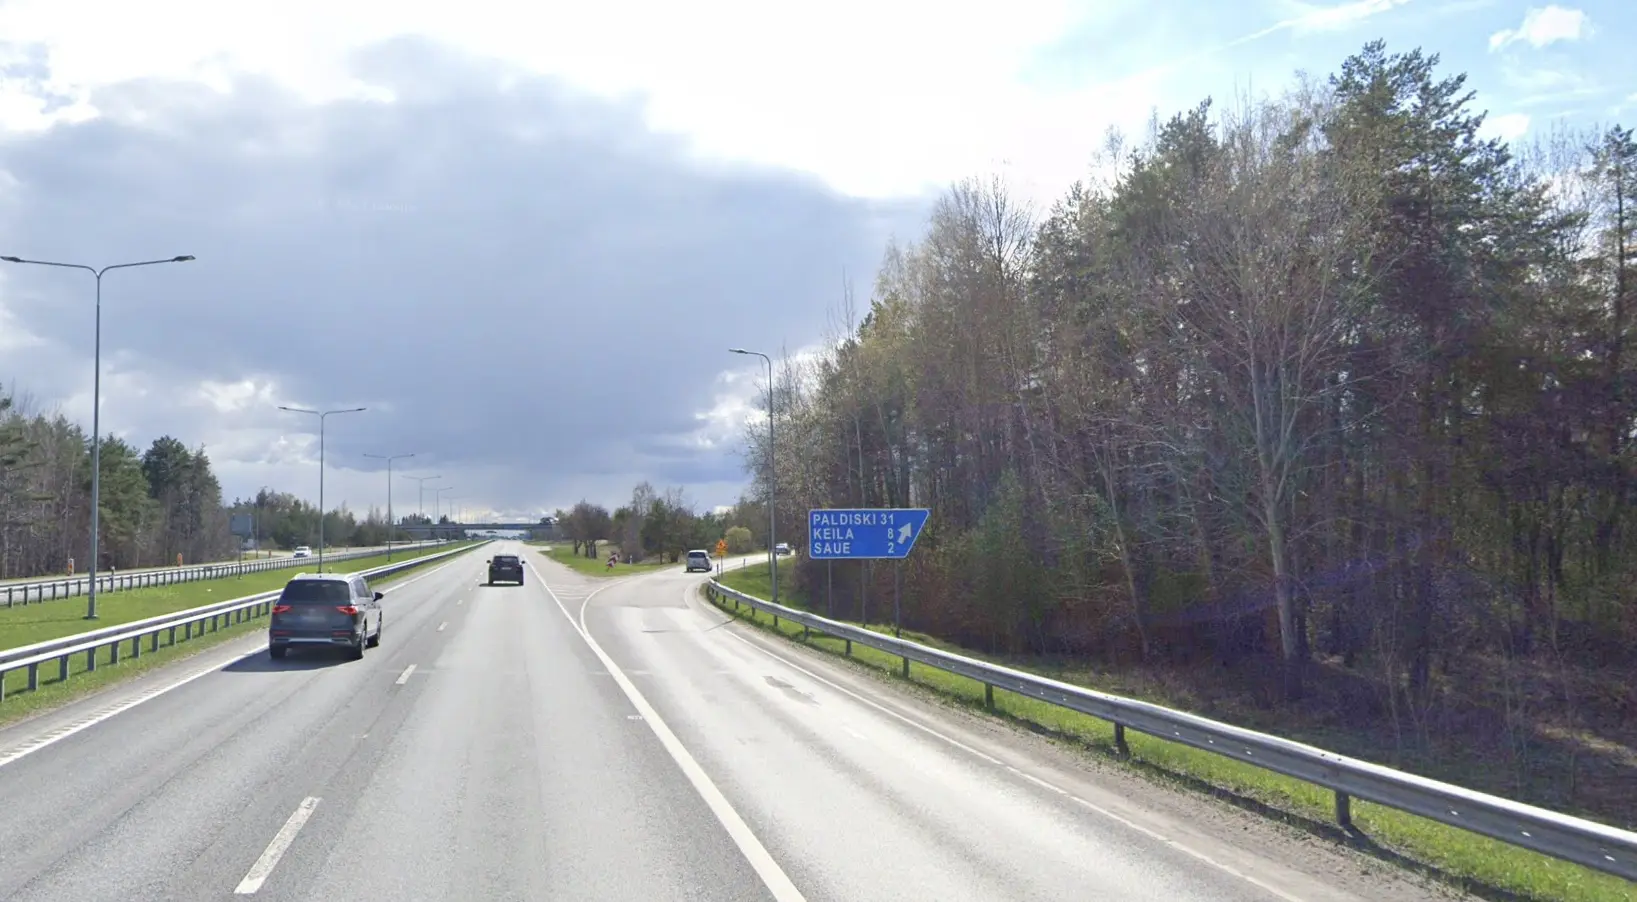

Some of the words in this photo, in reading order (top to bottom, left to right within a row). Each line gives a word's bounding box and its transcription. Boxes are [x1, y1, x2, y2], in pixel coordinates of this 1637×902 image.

[813, 514, 876, 525] PALDISKI
[881, 514, 894, 525] 31
[813, 528, 854, 540] KEILA
[887, 528, 894, 539] 8
[814, 542, 851, 554] SAUE
[888, 542, 894, 553] 2
